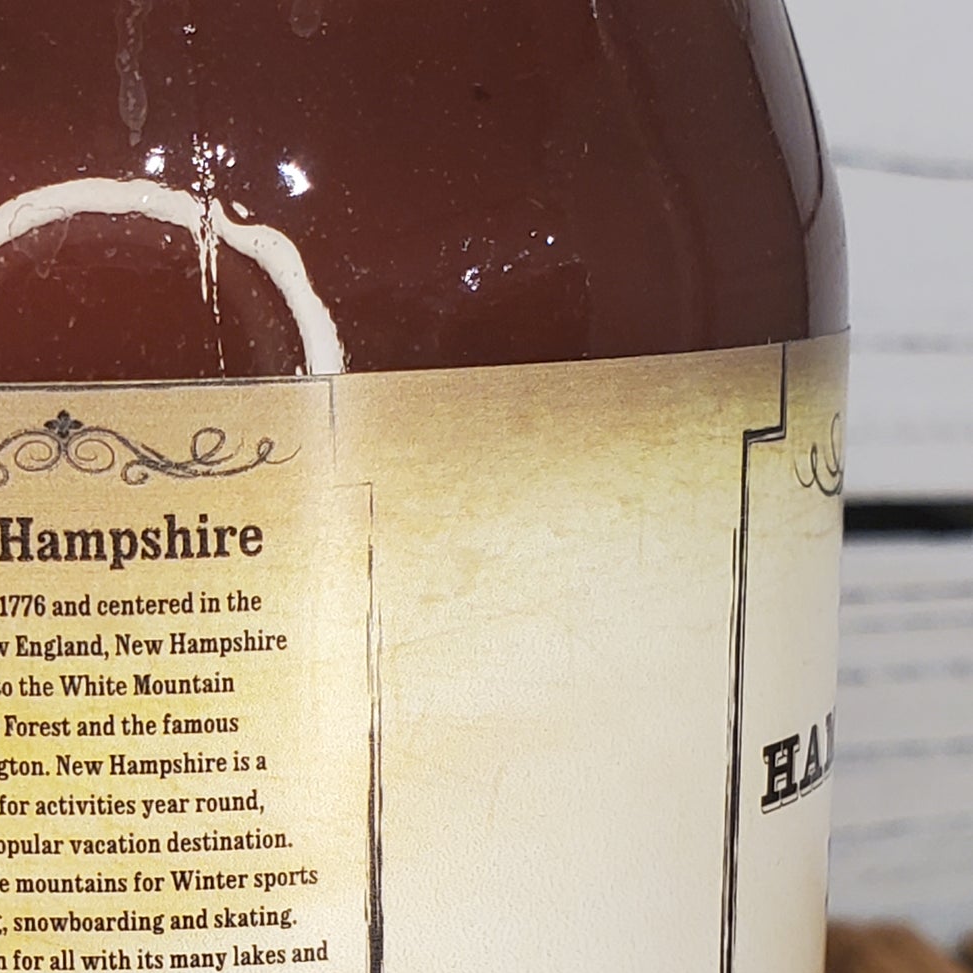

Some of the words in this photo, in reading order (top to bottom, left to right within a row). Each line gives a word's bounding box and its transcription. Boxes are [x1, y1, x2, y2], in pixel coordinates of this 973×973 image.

[51, 593, 92, 617] and
[96, 591, 194, 617] centered
[199, 591, 221, 614] in
[226, 589, 262, 613] the
[15, 633, 110, 662] England,
[114, 633, 164, 657] New
[169, 629, 288, 658] Hampshire
[18, 674, 54, 697] the
[59, 674, 128, 697] White
[132, 671, 235, 696] Mountain
[3, 714, 72, 738] Forest
[76, 713, 116, 737] and
[120, 713, 157, 736] the
[162, 712, 239, 735] famous
[35, 793, 137, 816] activities
[141, 797, 190, 820] year
[195, 788, 265, 815] round,
[68, 832, 162, 855] vacation
[166, 827, 293, 853] destination.
[15, 872, 128, 894] mountains
[133, 870, 166, 893] for
[169, 869, 249, 892] Winter
[253, 866, 319, 893] sports
[13, 909, 165, 936] snowboarding
[169, 907, 209, 931] and
[213, 905, 297, 930] skating.
